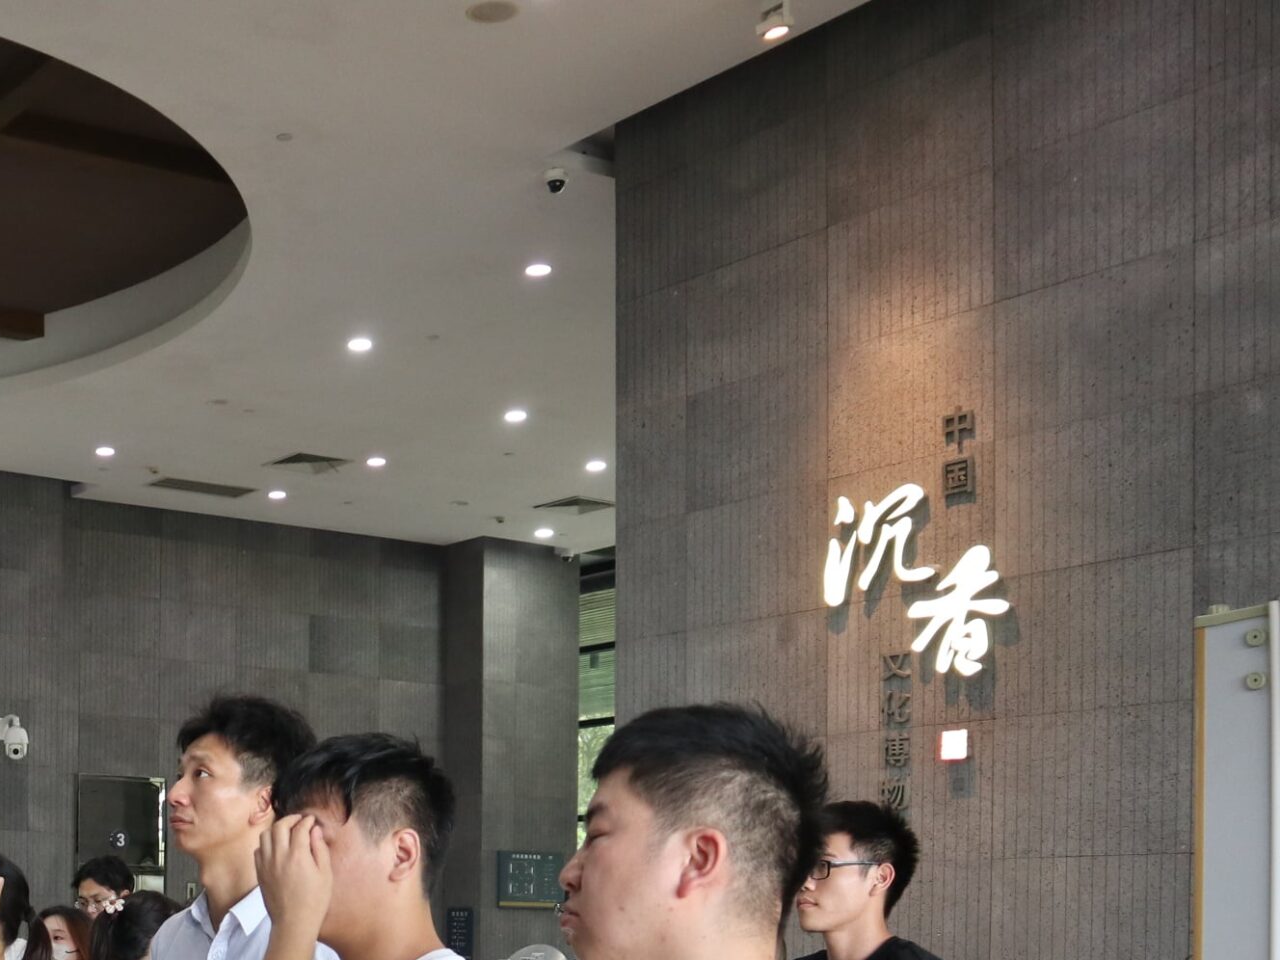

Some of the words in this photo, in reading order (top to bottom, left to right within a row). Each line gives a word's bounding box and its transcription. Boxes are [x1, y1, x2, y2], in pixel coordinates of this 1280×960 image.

[942, 405, 975, 497] 中国
[823, 483, 1010, 677] 沉香
[116, 833, 126, 847] 3
